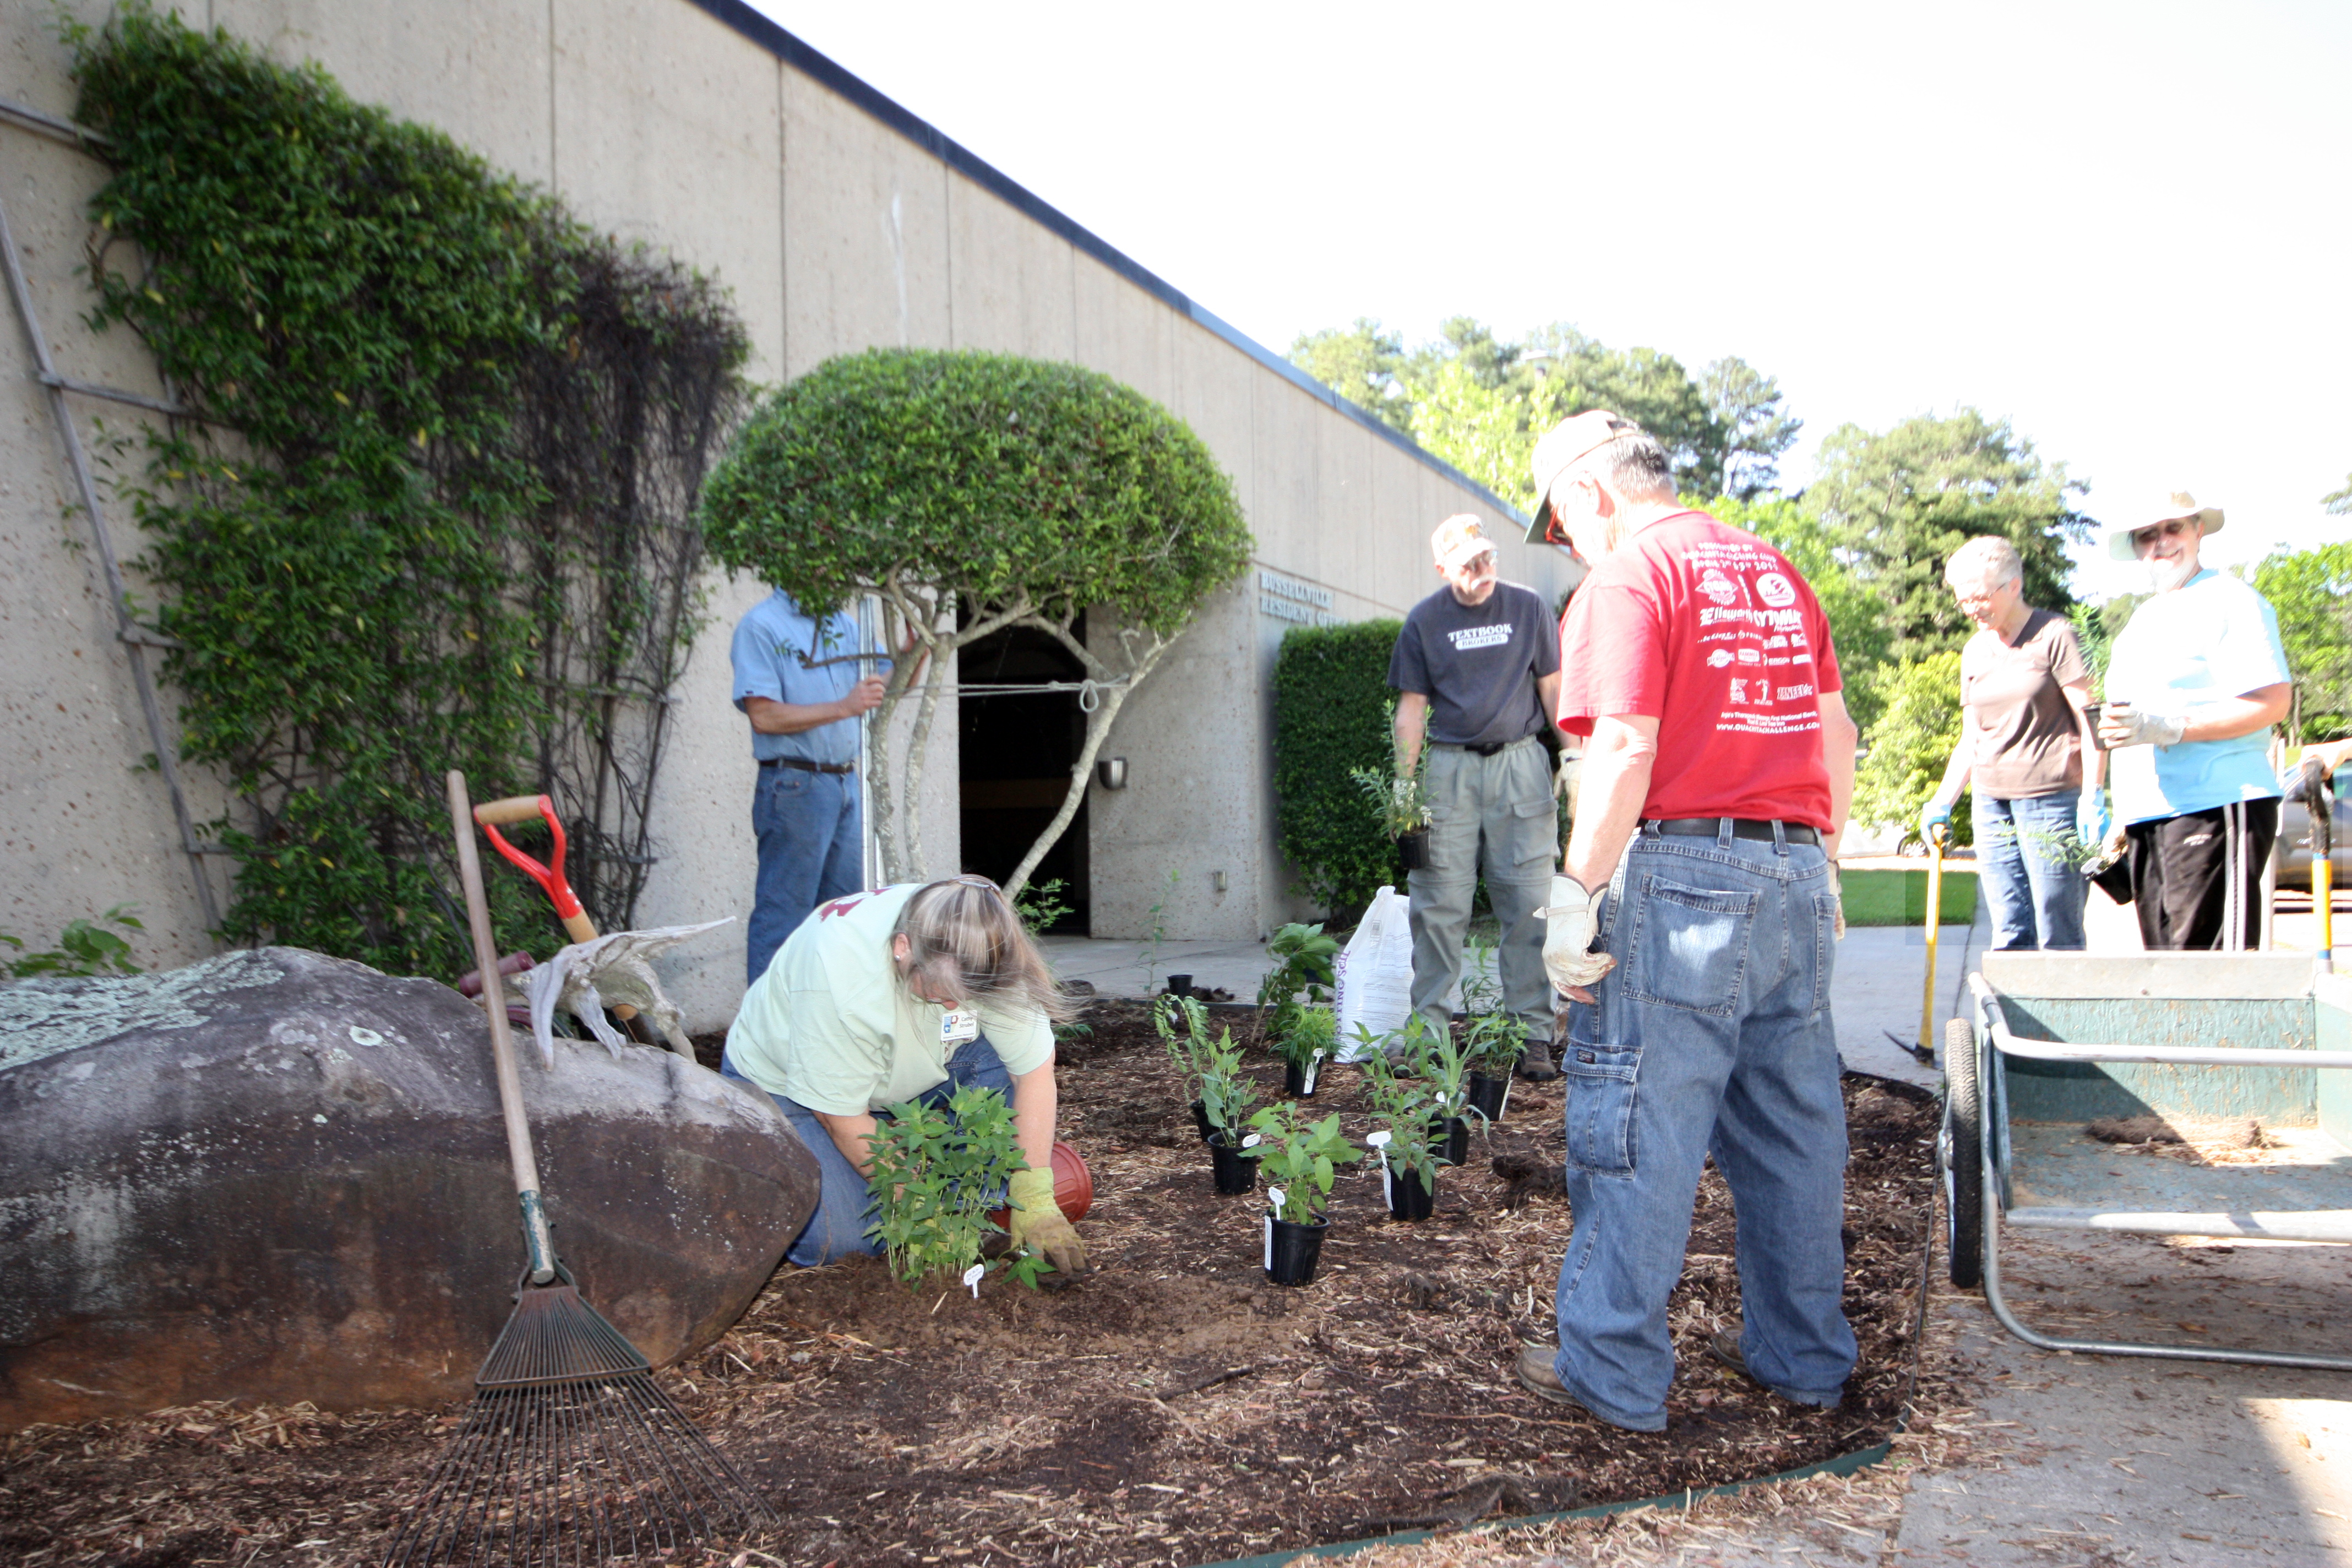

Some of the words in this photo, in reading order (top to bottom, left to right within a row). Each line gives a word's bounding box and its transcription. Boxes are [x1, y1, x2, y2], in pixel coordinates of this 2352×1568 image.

[1260, 571, 1333, 608] RUSSELLVILLE
[1260, 596, 1313, 625] RESIDENT
[1447, 624, 1513, 642] TEXTBOOK
[1462, 635, 1502, 647] BROKERS
